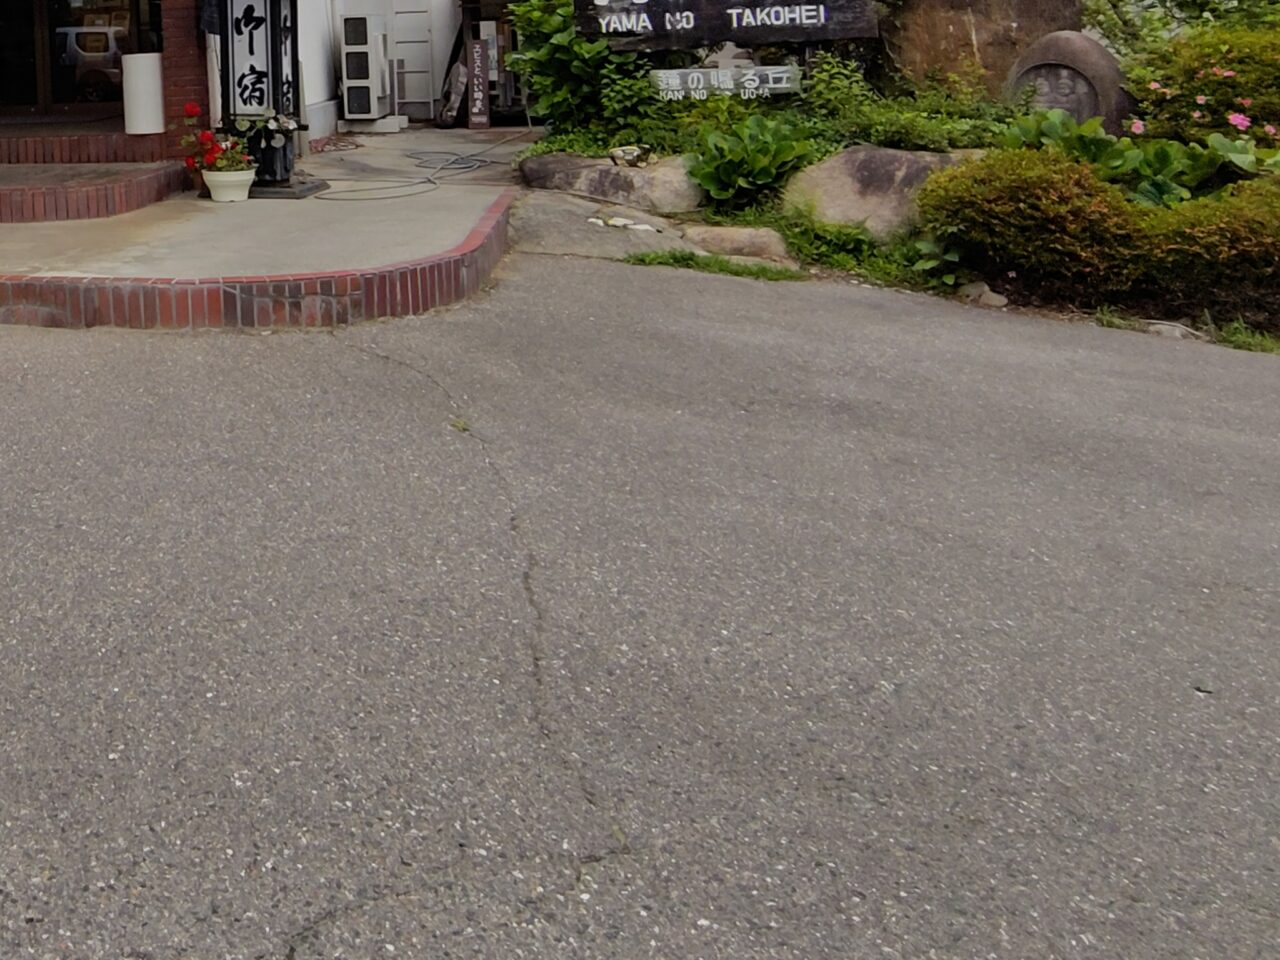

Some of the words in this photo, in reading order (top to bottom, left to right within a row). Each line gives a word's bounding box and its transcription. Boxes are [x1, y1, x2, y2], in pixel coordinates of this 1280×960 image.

[598, 13, 653, 33] YAMA
[665, 10, 695, 30] NO
[727, 4, 826, 28] TAKOHEI
